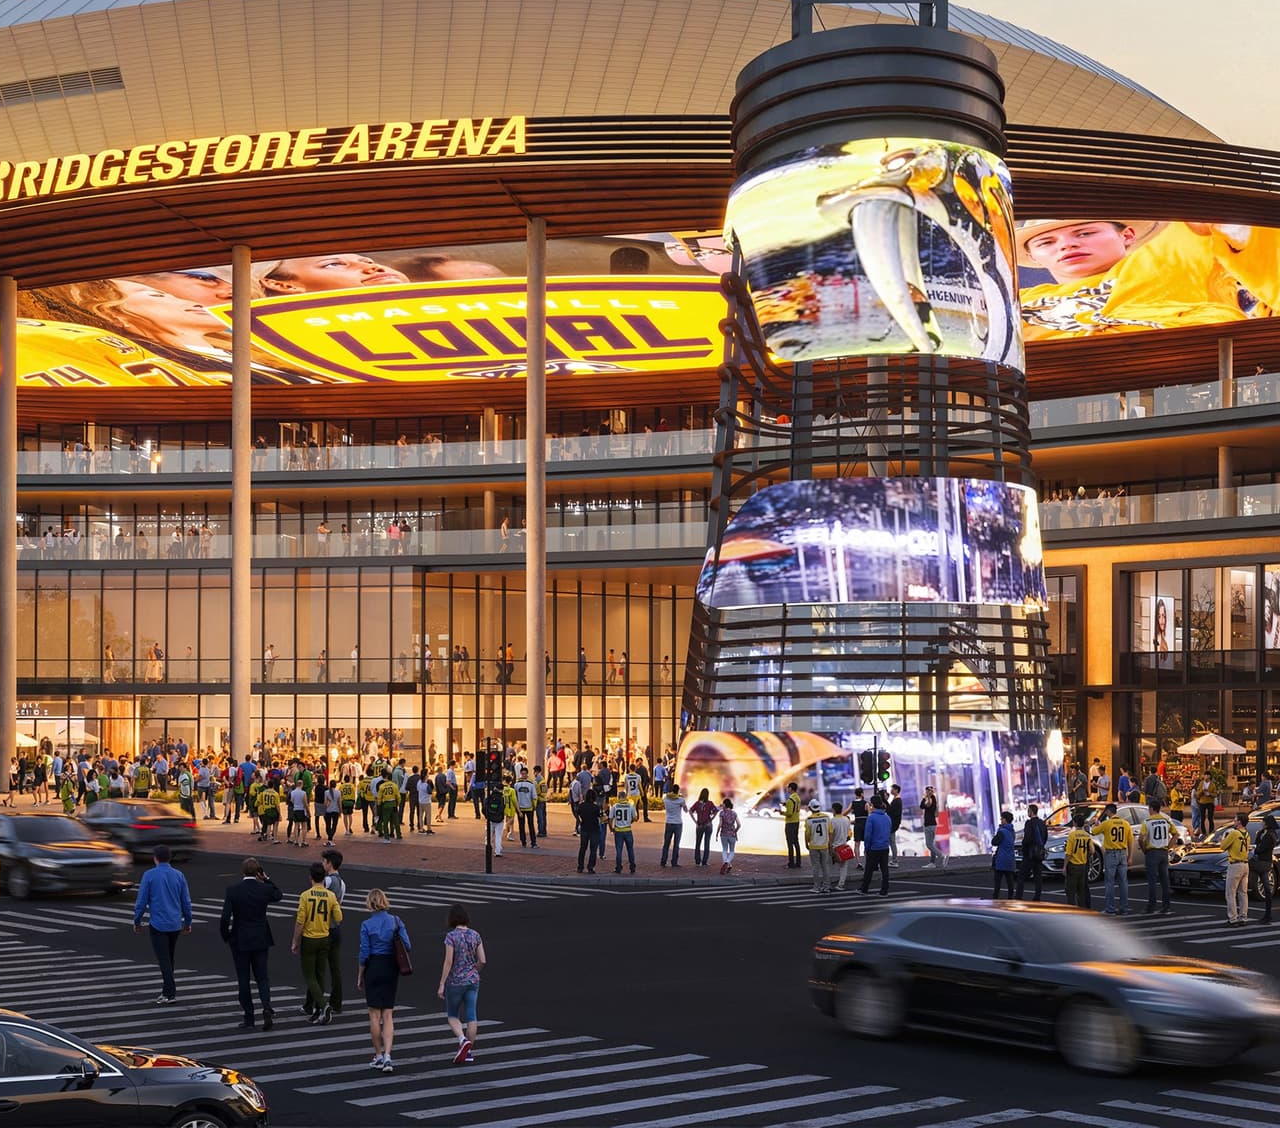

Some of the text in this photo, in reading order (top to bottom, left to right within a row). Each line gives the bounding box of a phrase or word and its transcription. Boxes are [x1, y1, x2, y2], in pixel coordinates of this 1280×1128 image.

[331, 115, 526, 164] ARENA
[304, 299, 680, 326] SMASHVILLE
[325, 314, 713, 362] LOYAL
[816, 824, 823, 837] 4
[308, 898, 329, 922] 74
